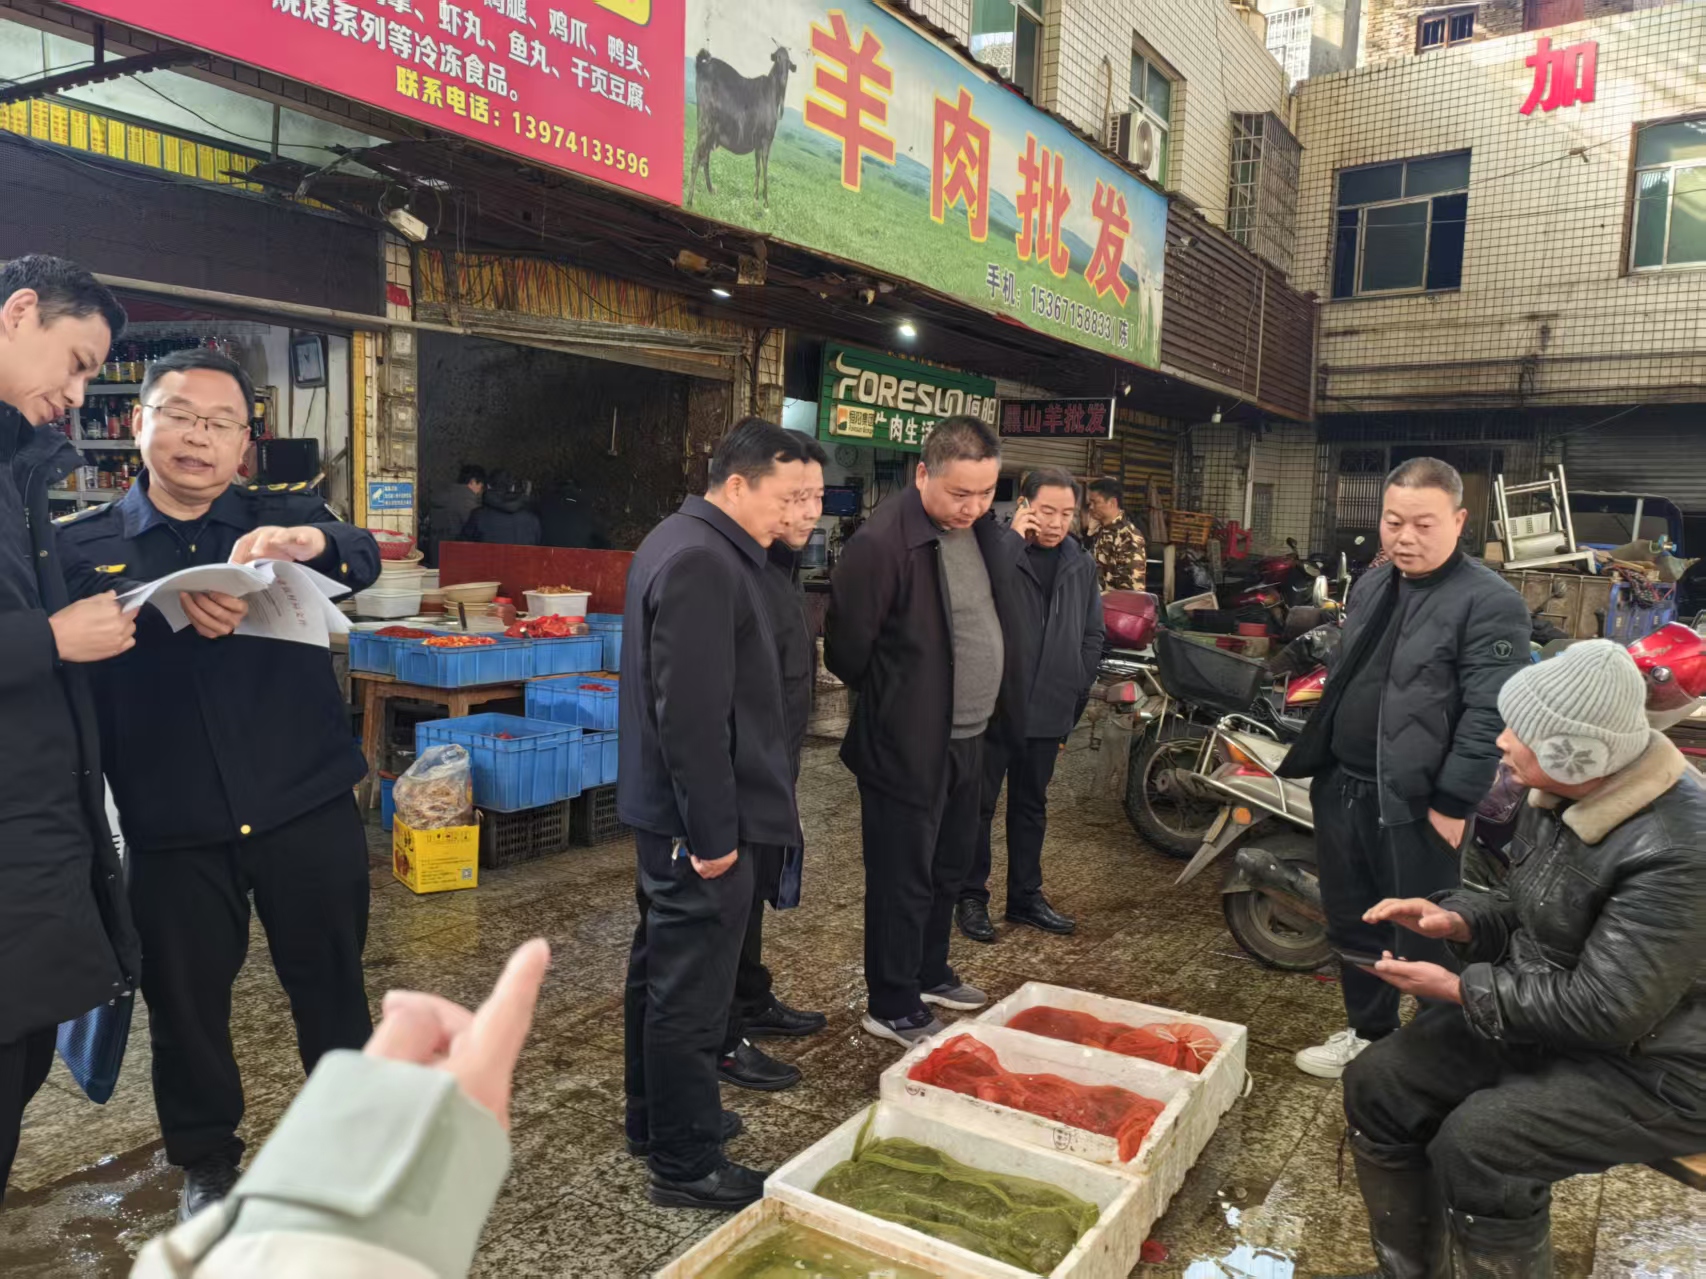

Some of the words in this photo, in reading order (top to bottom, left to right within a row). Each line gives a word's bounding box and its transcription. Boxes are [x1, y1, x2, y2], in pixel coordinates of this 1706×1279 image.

[1520, 36, 1599, 116] 加
[804, 9, 1132, 306] 羊肉批发
[835, 352, 964, 418] FORESUN
[1003, 403, 1107, 433] 黑山羊批发
